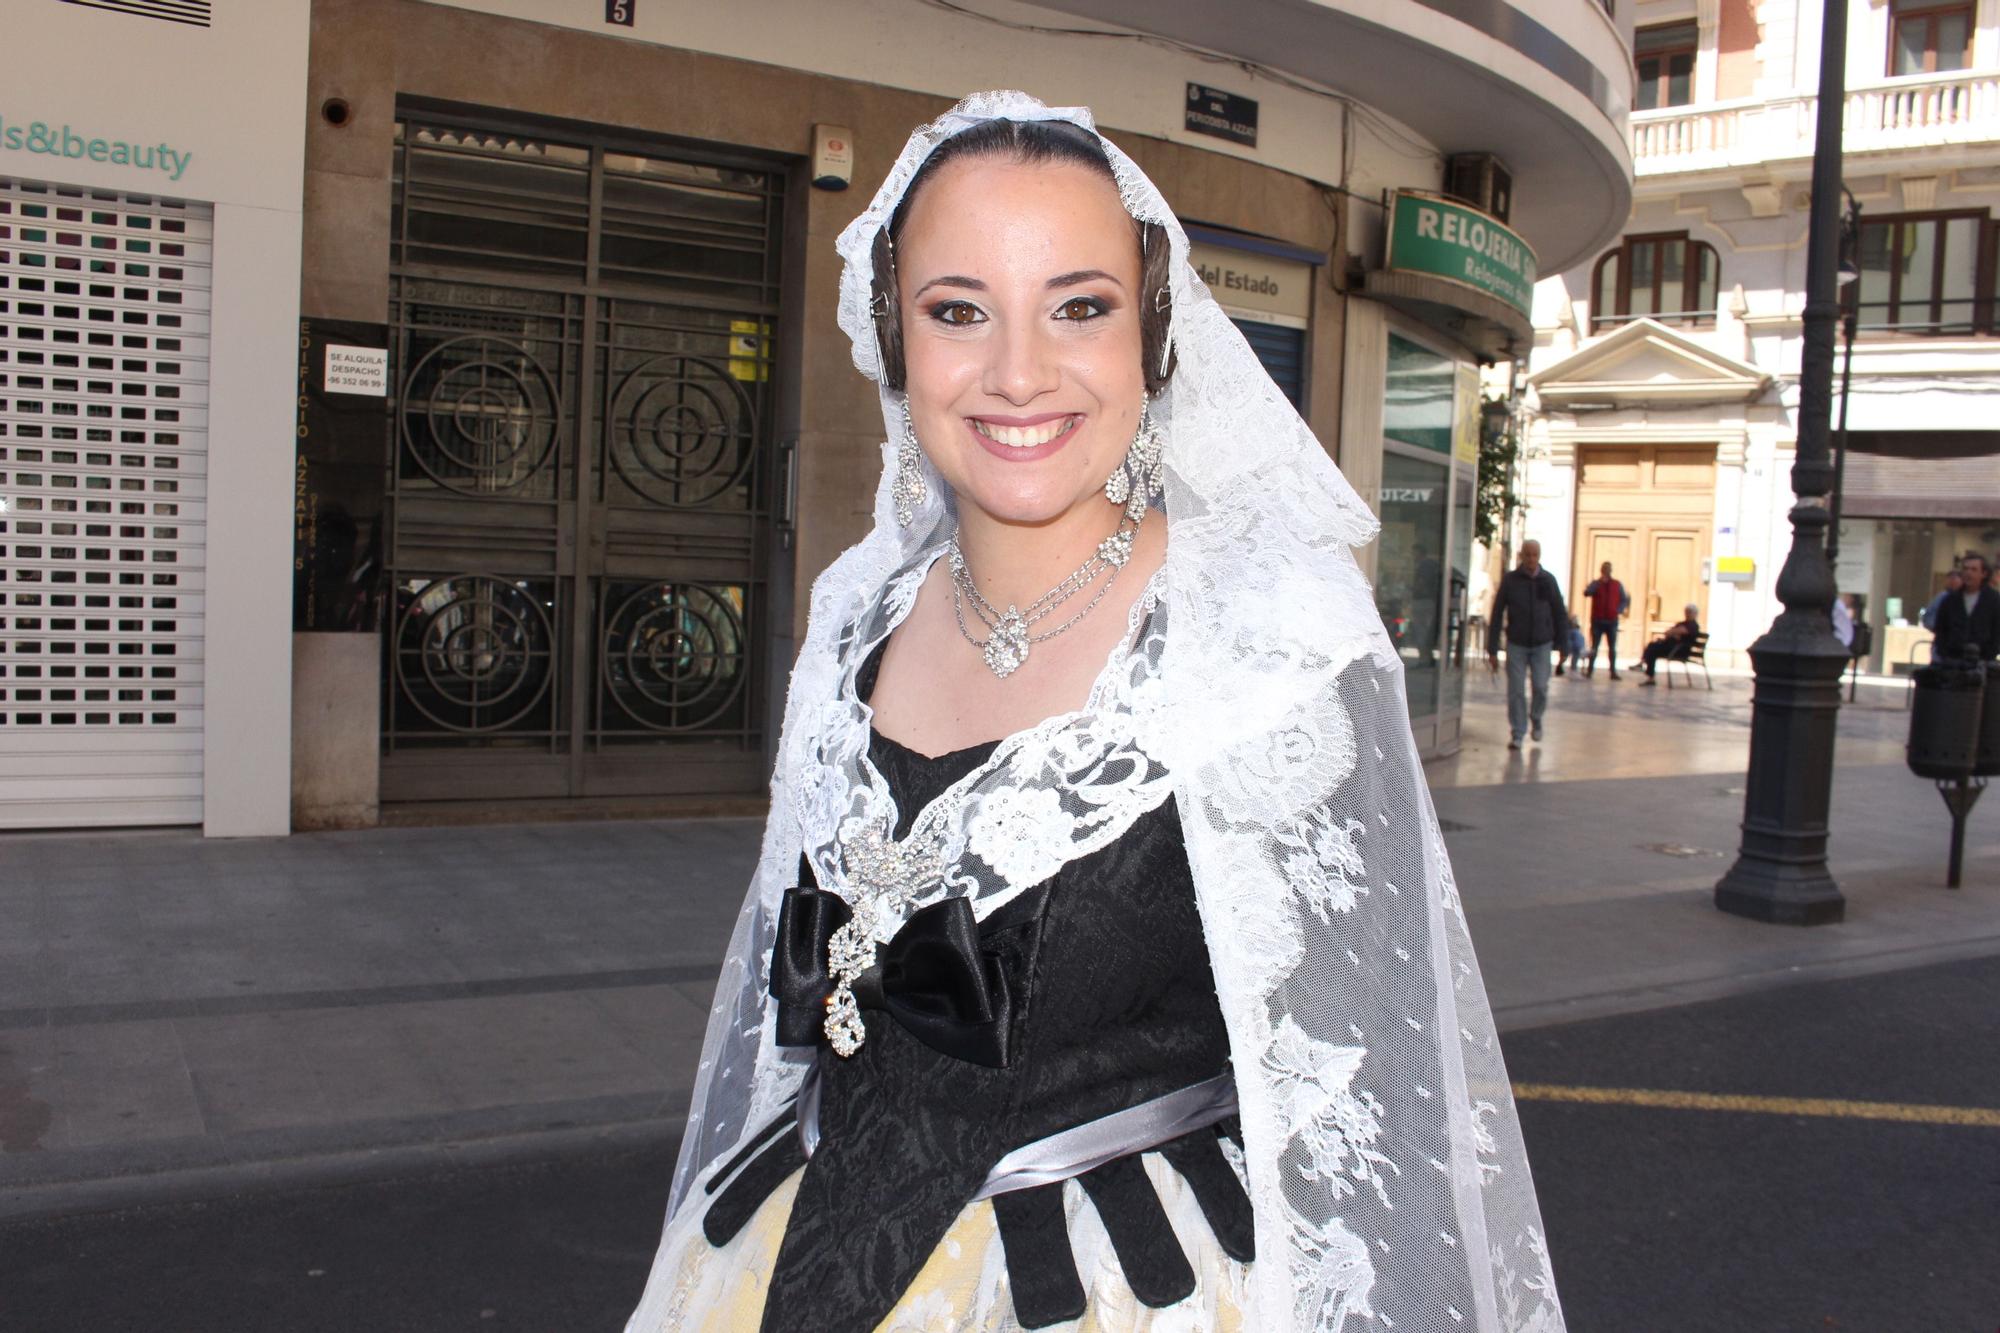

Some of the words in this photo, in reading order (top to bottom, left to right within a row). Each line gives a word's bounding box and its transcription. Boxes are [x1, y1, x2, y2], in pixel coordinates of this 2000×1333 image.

[614, 0, 627, 22] 5
[1224, 269, 1278, 297] Estado
[330, 352, 342, 361] SE
[344, 354, 383, 365] ALQUILA
[331, 364, 381, 376] DESPACHO
[297, 321, 311, 438] EDIFICIO
[296, 454, 308, 541] AZZATI
